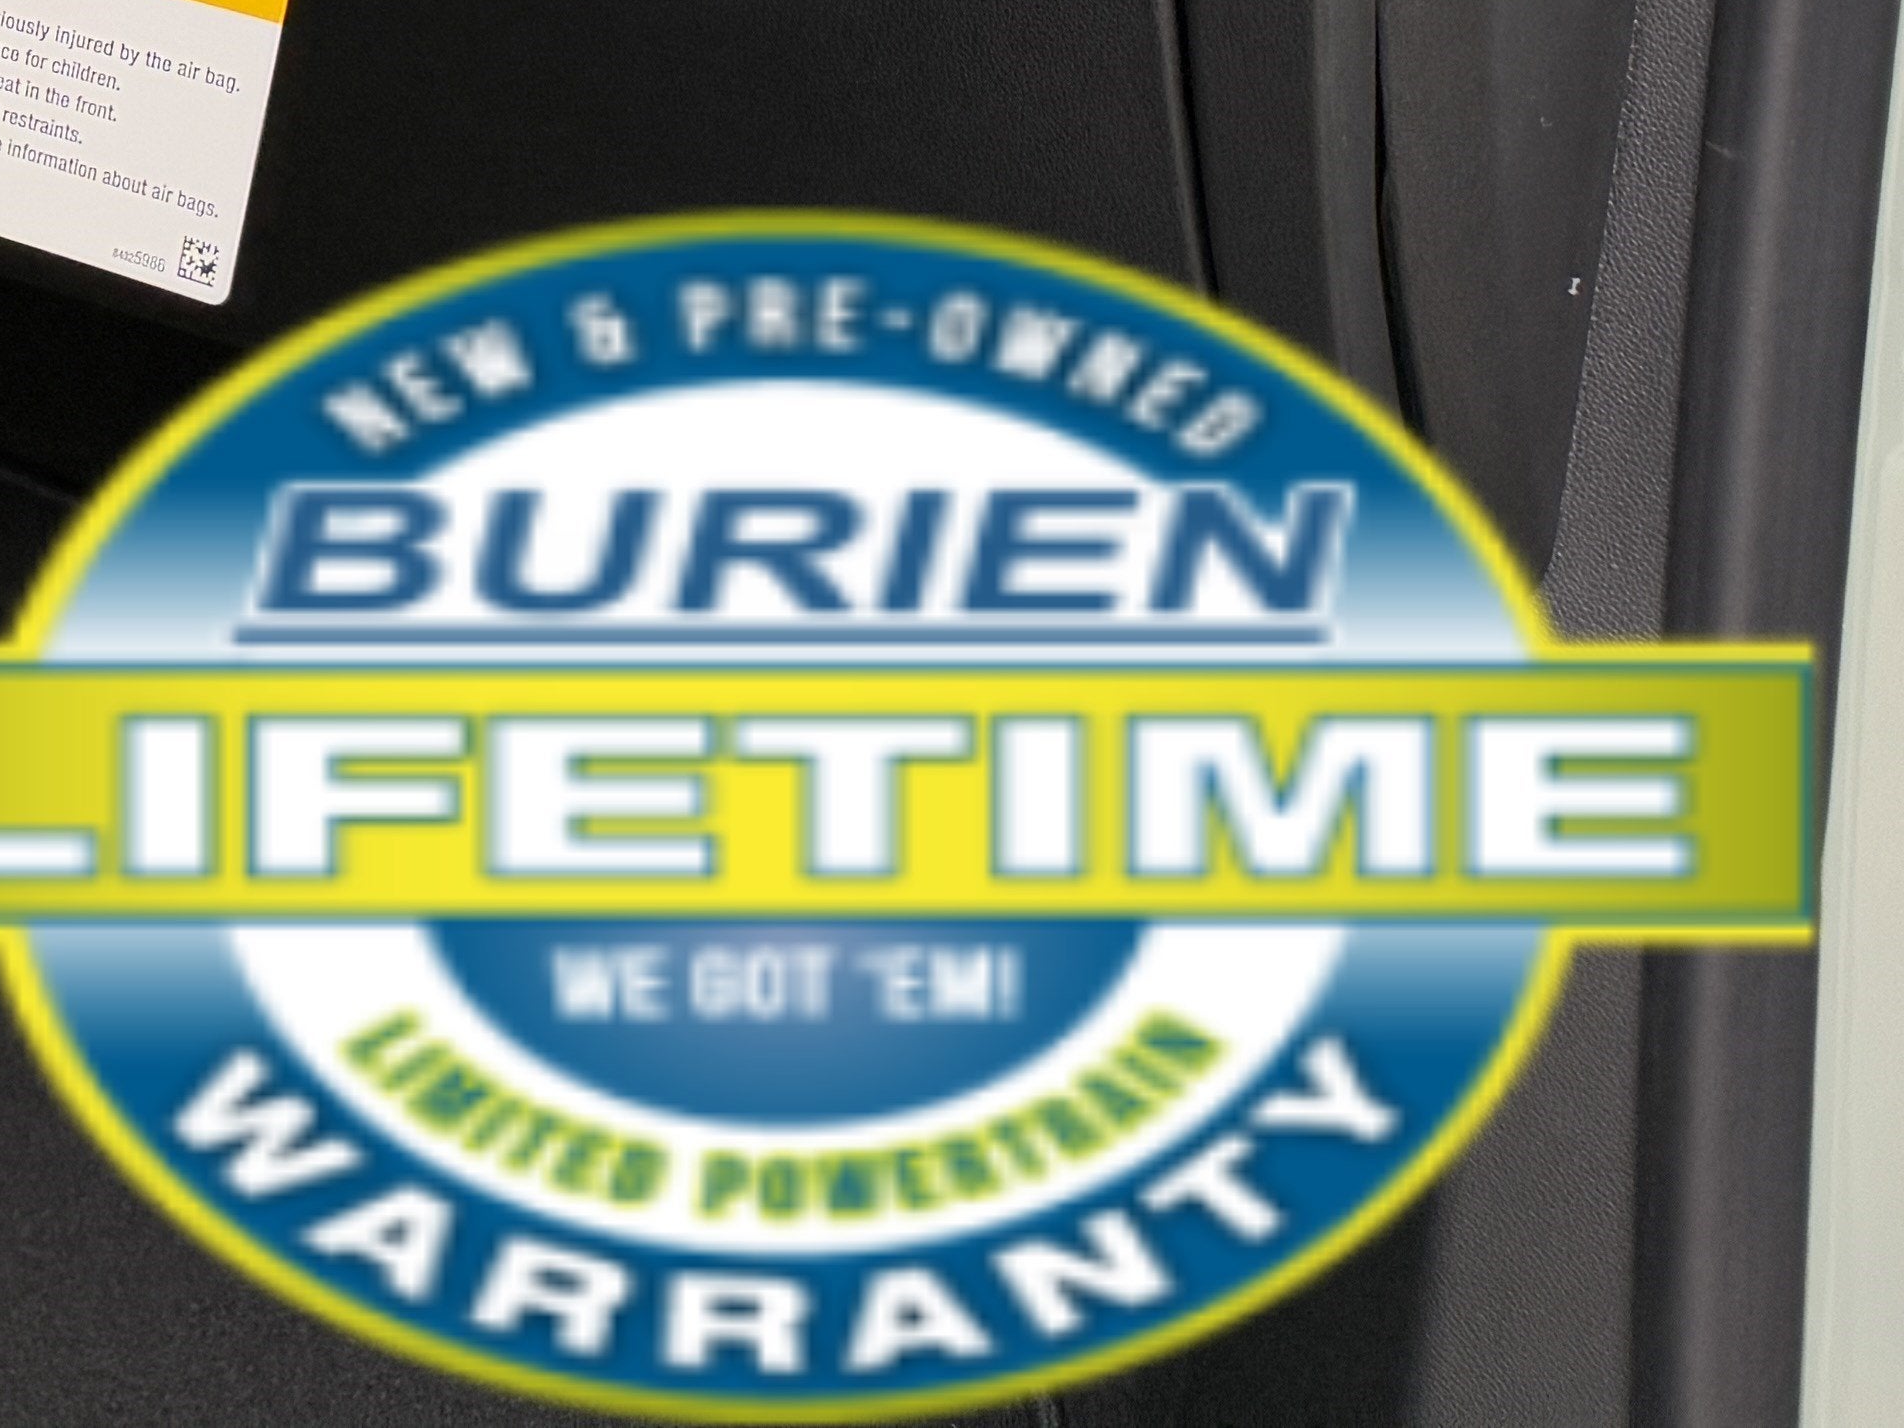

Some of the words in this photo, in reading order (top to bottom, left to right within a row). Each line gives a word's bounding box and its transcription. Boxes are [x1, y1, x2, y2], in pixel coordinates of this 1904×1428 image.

[24, 47, 49, 70] for
[50, 57, 121, 92] children.
[53, 23, 115, 57] injured
[118, 41, 141, 67] by
[144, 49, 172, 72] the
[176, 60, 201, 80] air
[204, 65, 240, 94] bag.
[23, 78, 40, 101] in
[44, 85, 70, 108] the
[74, 94, 117, 122] front.
[1, 108, 83, 145] restraints.
[6, 137, 97, 182] information
[100, 169, 148, 197] about
[150, 183, 174, 204] air
[175, 188, 219, 218] bags.
